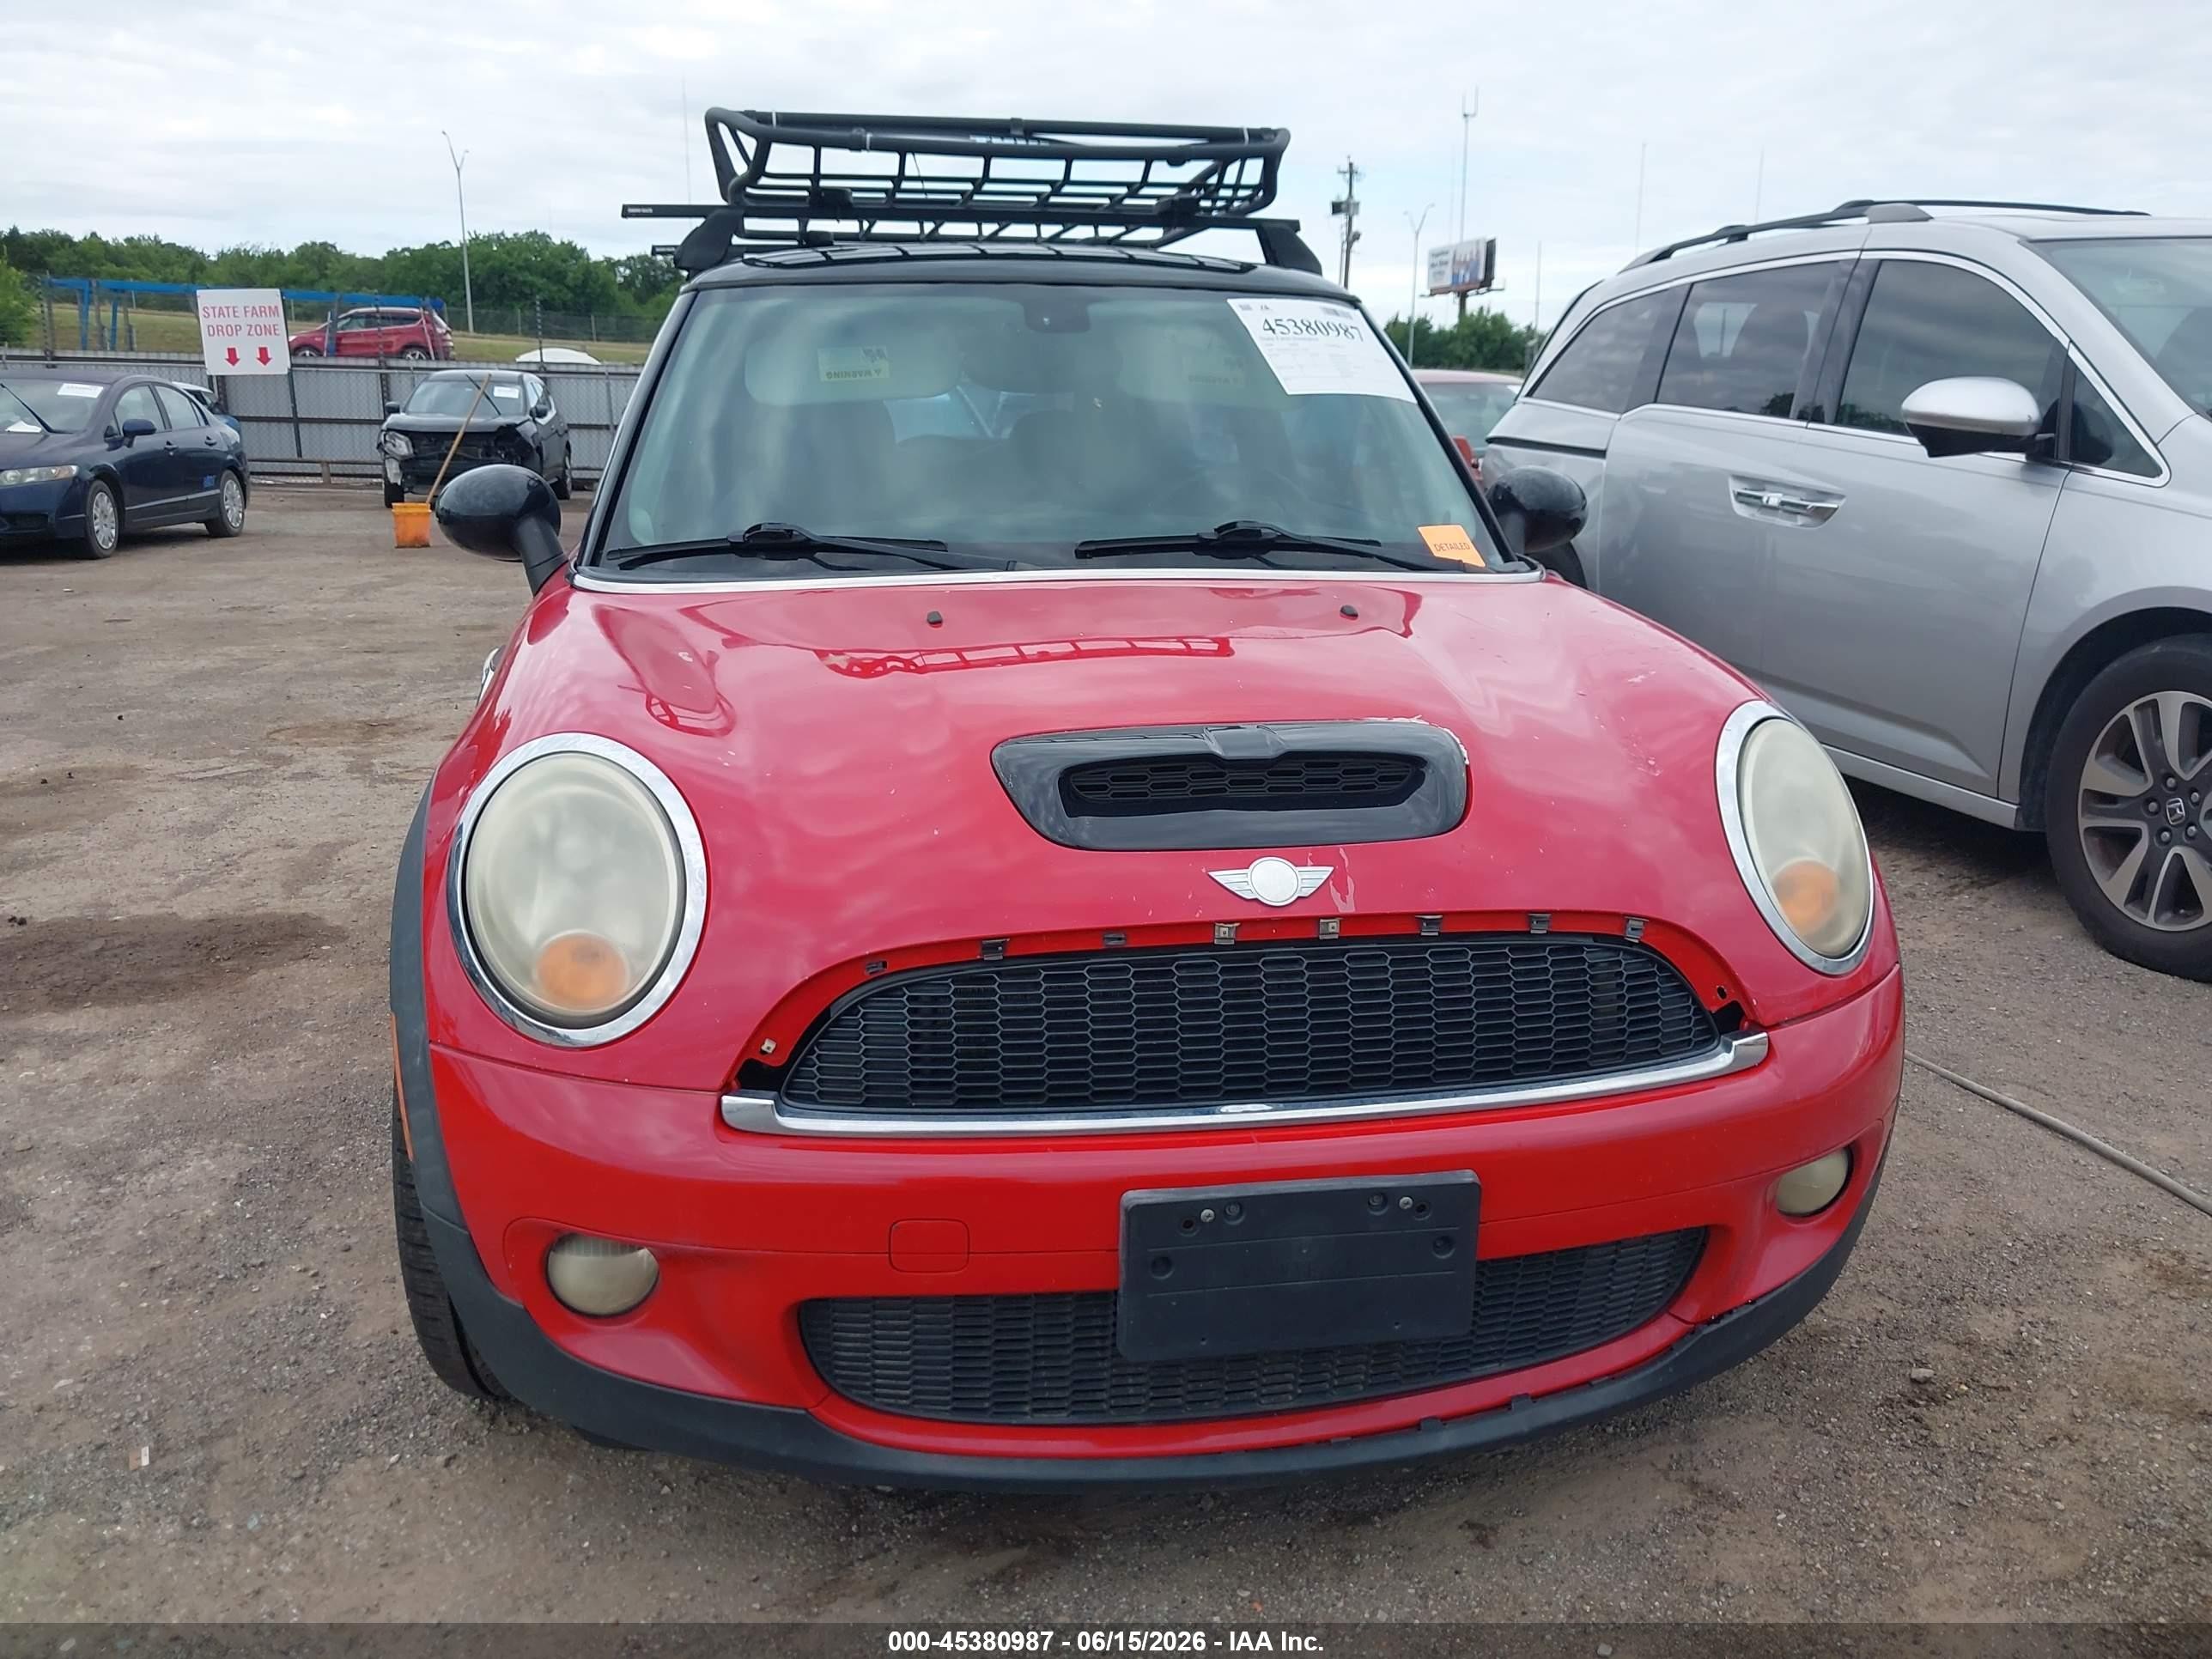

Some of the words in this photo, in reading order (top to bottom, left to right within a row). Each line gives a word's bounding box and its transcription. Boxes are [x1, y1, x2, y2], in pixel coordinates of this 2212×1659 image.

[202, 305, 240, 319] STATE
[244, 305, 280, 318] FARM
[207, 324, 242, 337] DROP
[246, 323, 281, 337] ZONE
[1262, 318, 1364, 343] 45380987
[1433, 542, 1471, 552] DETAILED
